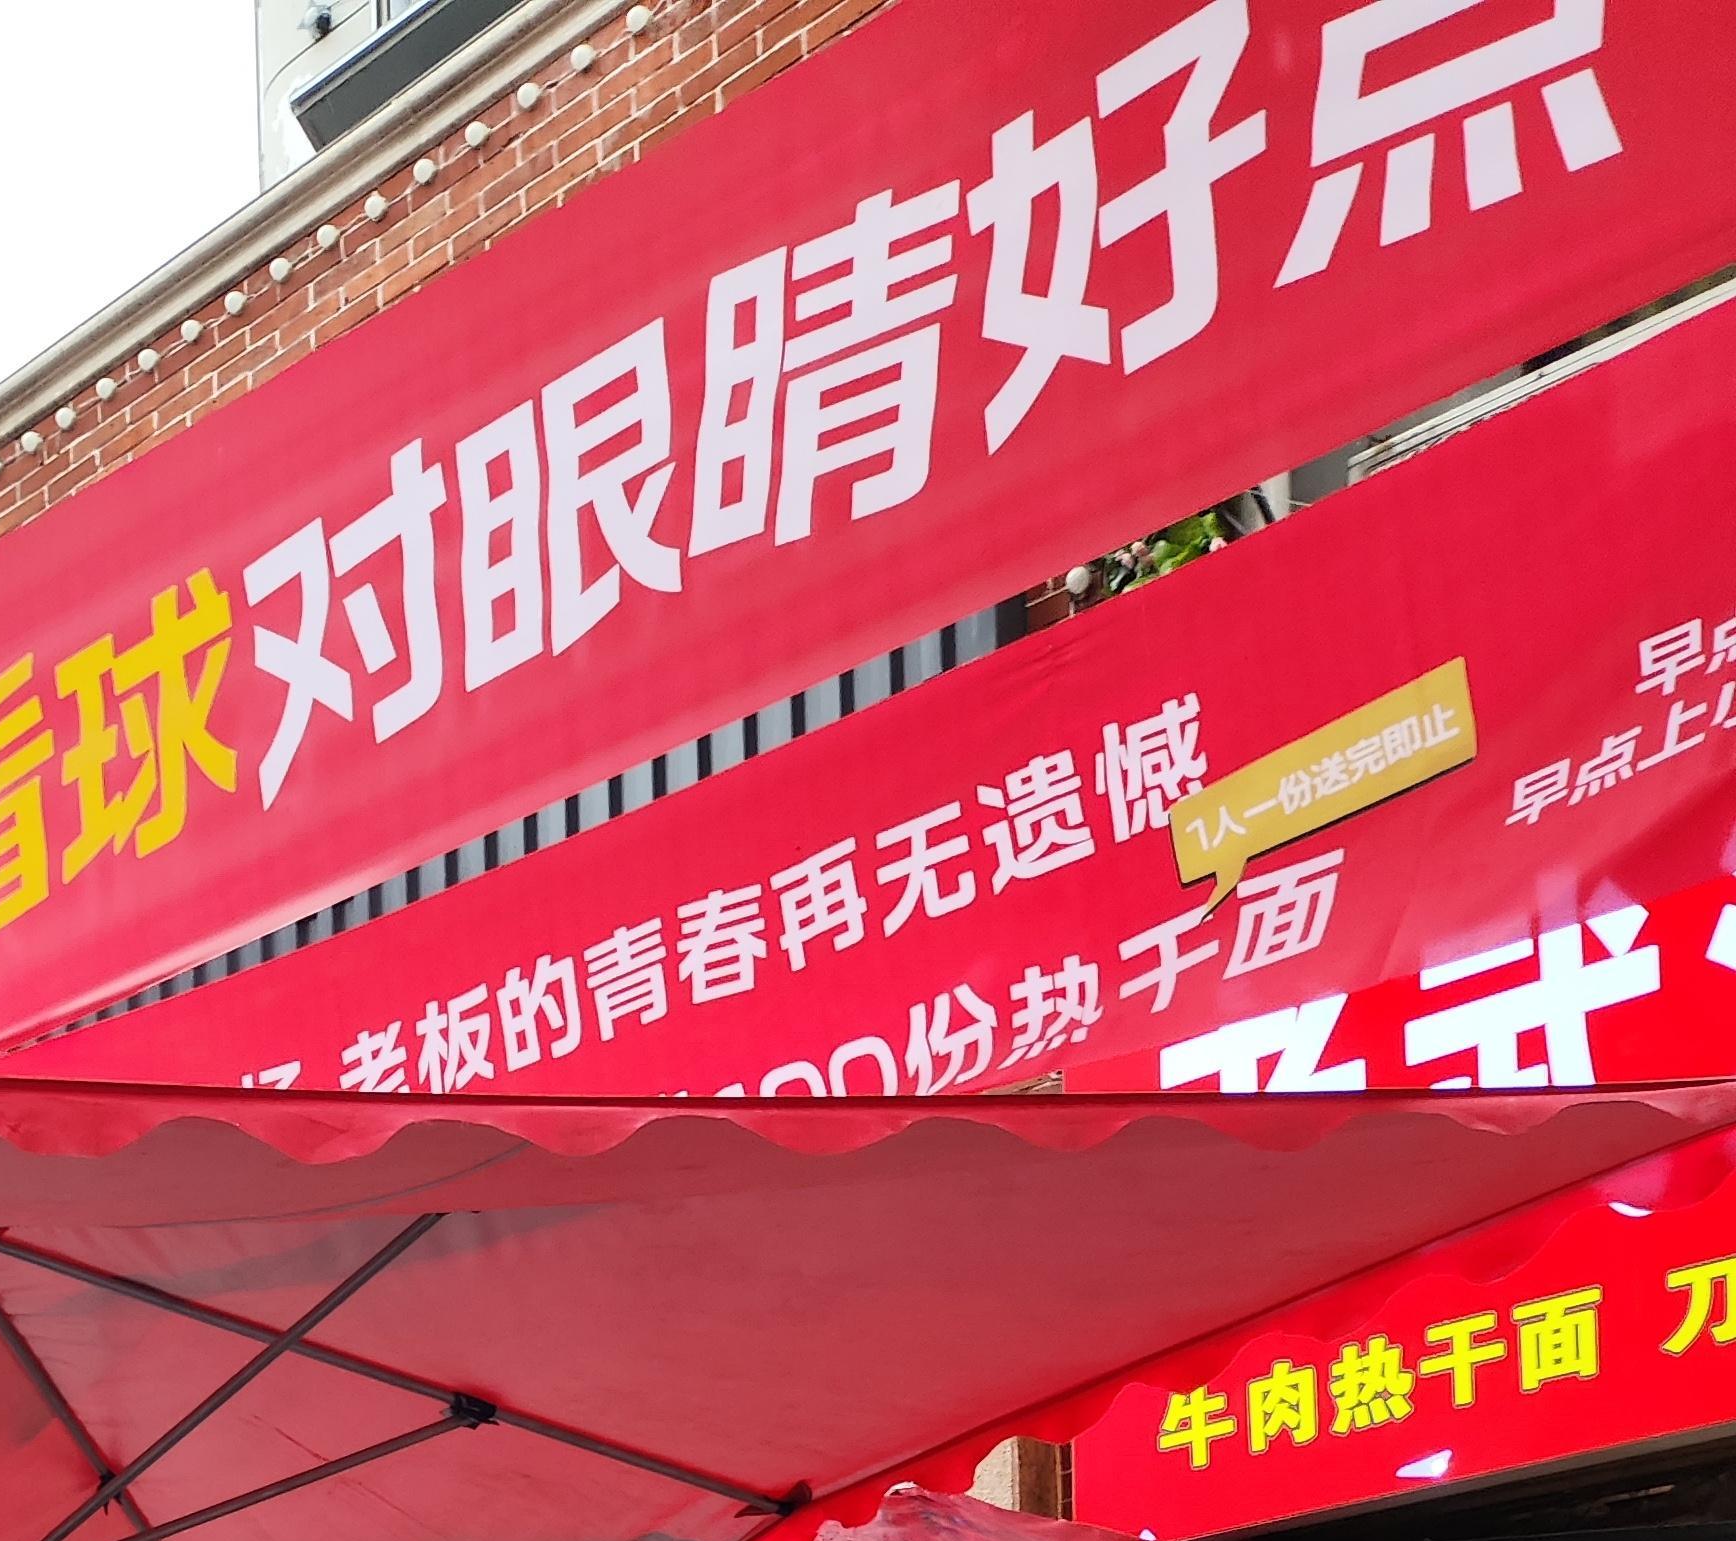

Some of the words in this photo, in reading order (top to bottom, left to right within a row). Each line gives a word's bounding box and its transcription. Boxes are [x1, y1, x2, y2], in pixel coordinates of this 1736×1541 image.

[1185, 702, 1462, 850] 1人一份送完即止
[1157, 1285, 1603, 1469] 牛肉热干面
